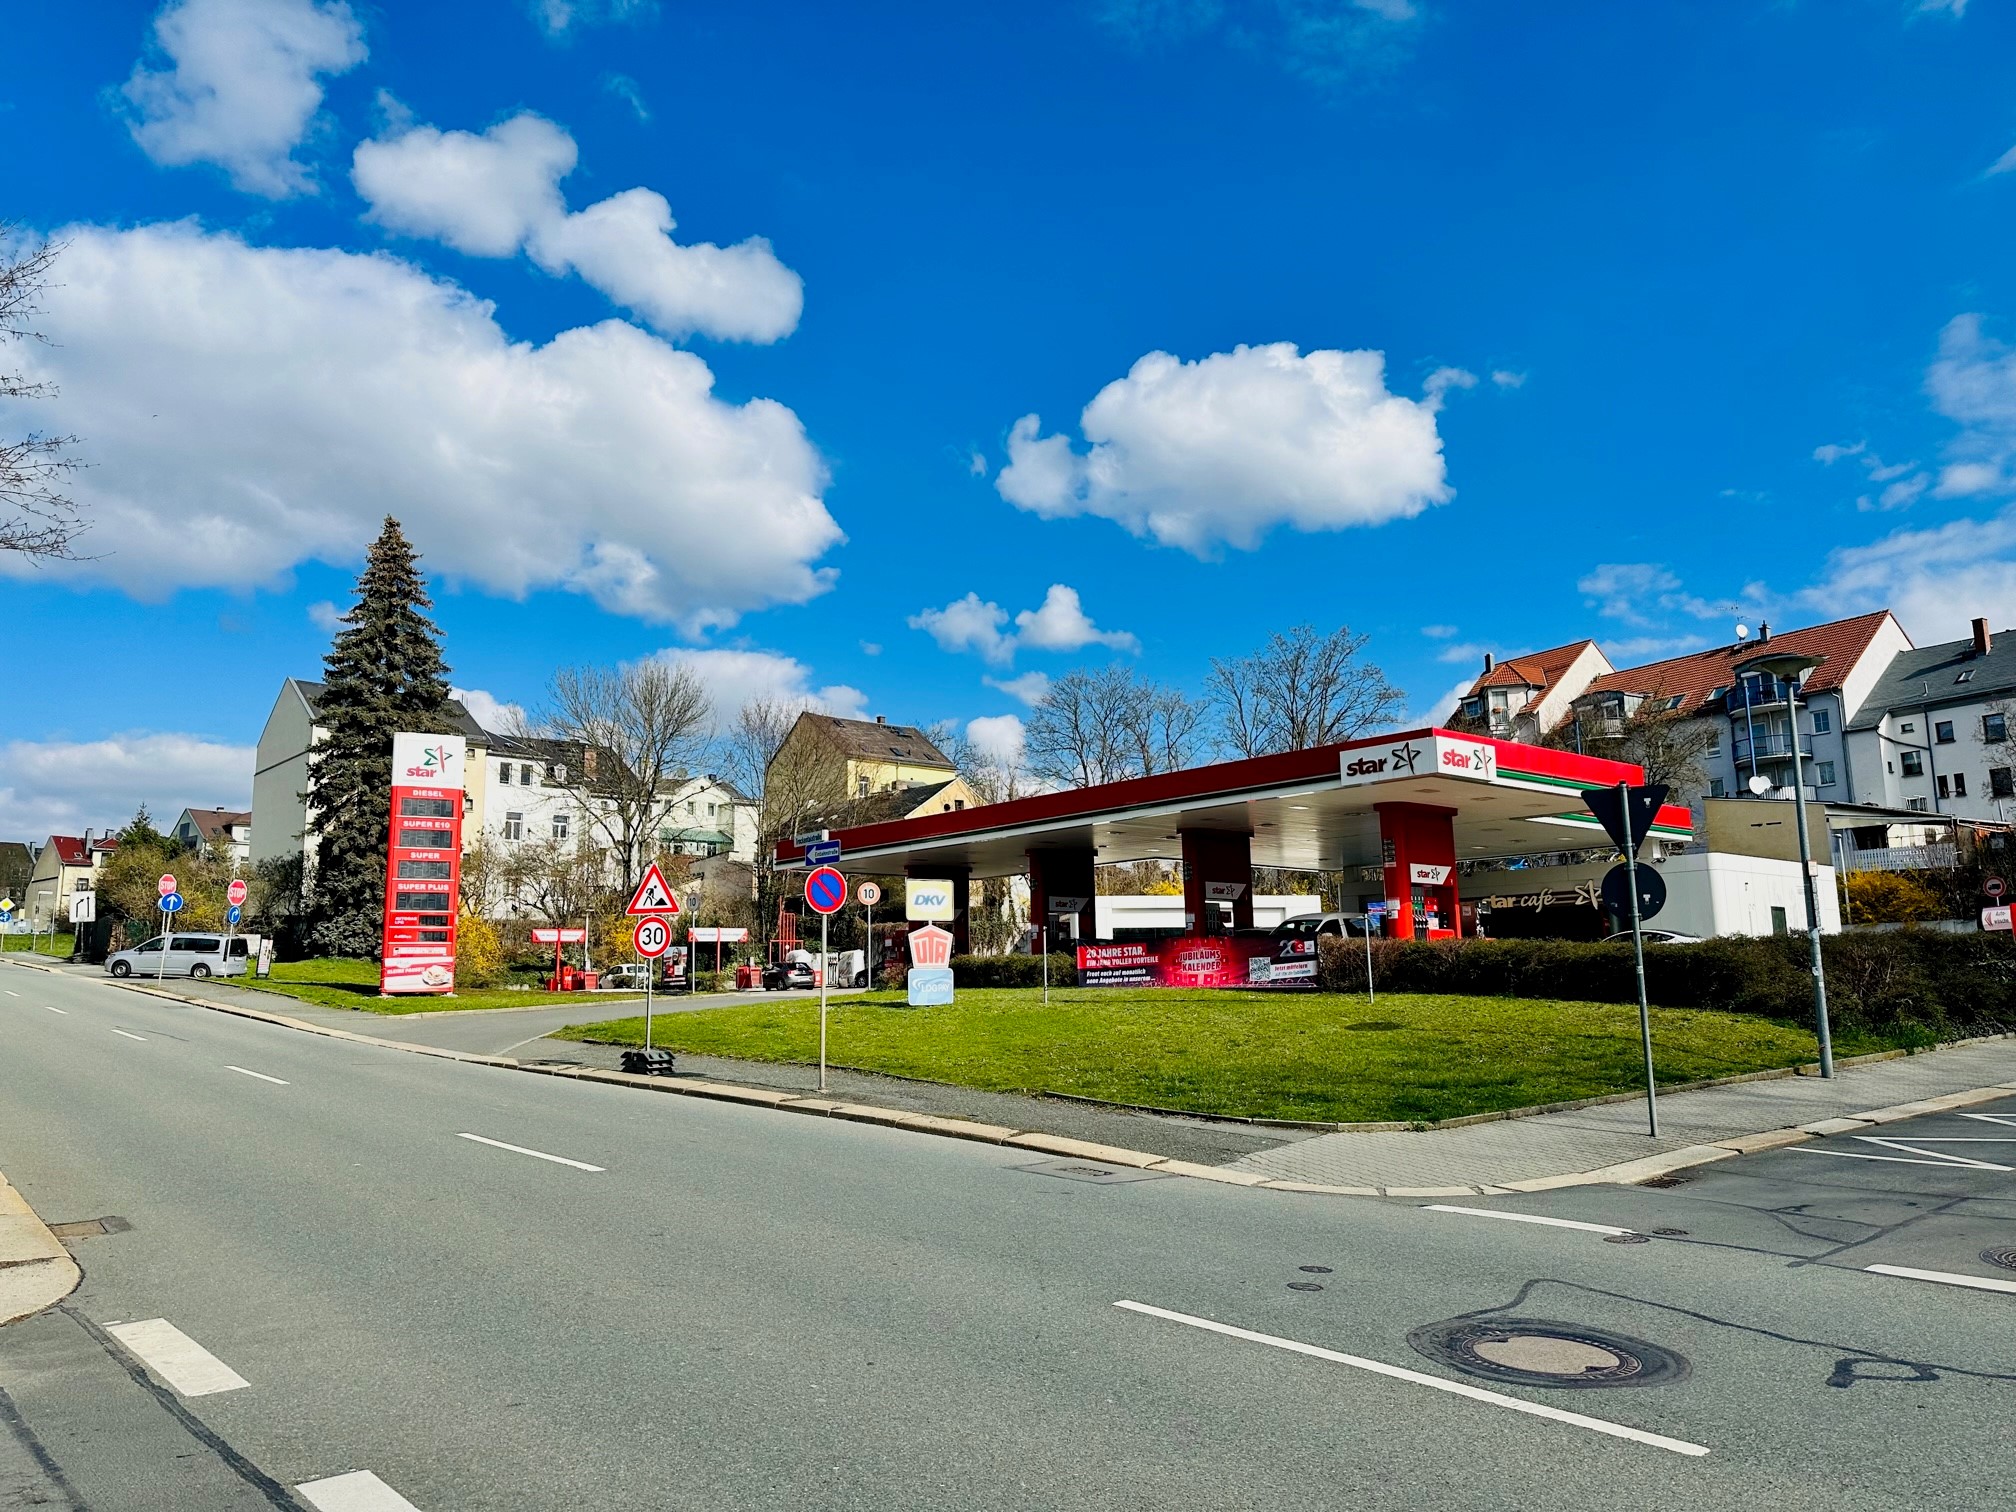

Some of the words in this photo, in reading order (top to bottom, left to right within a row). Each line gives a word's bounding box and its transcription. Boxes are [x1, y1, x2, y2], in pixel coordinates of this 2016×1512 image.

[1443, 749, 1471, 769] star
[406, 766, 437, 778] star
[1346, 757, 1388, 777] star
[412, 789, 444, 798] DIESEL
[403, 820, 433, 828] SUPER
[434, 821, 450, 829] E10
[410, 851, 440, 859] SUPER
[814, 848, 838, 858] Einbahnstraße
[1417, 869, 1431, 879] star
[160, 881, 175, 890] STOP
[428, 883, 449, 891] PLUS
[1212, 886, 1225, 895] star
[229, 888, 246, 898] STOP
[864, 888, 875, 899] 10
[689, 897, 697, 907] 10
[914, 894, 946, 906] DKV
[1520, 888, 1557, 913] café
[641, 927, 664, 945] 30
[913, 928, 949, 964] UTA
[1086, 948, 1097, 959] 20
[1097, 947, 1122, 958] JAHRE
[1123, 946, 1146, 957] STAR,
[1179, 948, 1221, 962] JUBILÄUMS
[1111, 957, 1132, 966] VOLLER
[1132, 955, 1159, 964] VORTEILE
[1182, 961, 1221, 972] KALENDER
[1121, 968, 1146, 976] monatlich
[1099, 976, 1123, 985] Angebote
